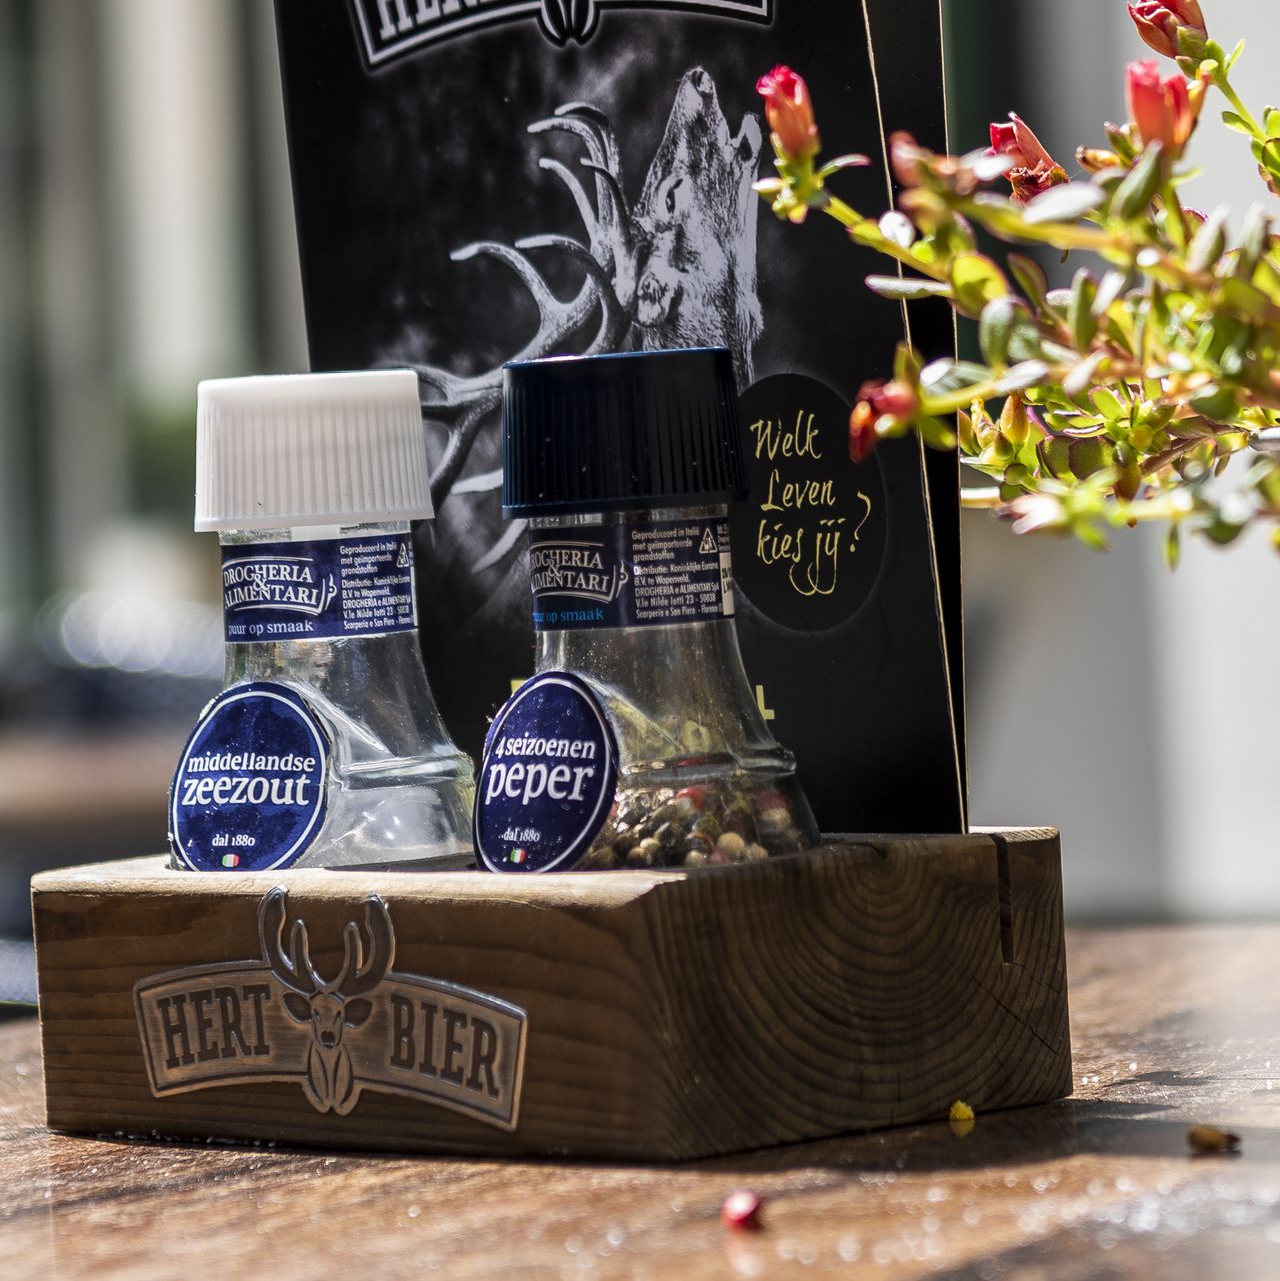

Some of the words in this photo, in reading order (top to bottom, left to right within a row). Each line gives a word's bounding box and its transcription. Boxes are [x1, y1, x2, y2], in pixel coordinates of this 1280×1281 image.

[749, 410, 822, 461] Welk
[760, 468, 836, 512] Leven
[632, 528, 677, 541] Geproduceerd
[678, 528, 684, 536] in
[757, 519, 804, 565] kies
[632, 542, 646, 551] met
[341, 557, 353, 565] met
[633, 550, 674, 563] grondstoffen
[223, 564, 314, 587] DROGHERIA
[253, 573, 269, 591] &
[634, 577, 646, 586] B.V.
[224, 585, 319, 610] ALIMENTARI
[635, 586, 674, 597] DROGHERIA
[680, 583, 711, 593] ALIMENTARI
[342, 598, 377, 609] DROGHERIA
[650, 597, 669, 606] Nilde
[686, 595, 694, 604] 23
[356, 608, 372, 618] Nilde
[546, 611, 558, 624] op
[561, 608, 604, 620] smaak
[636, 609, 664, 619] Scarperia
[670, 607, 680, 616] San
[249, 623, 264, 637] op
[266, 620, 314, 634] smaak
[187, 751, 315, 773] middellandse
[182, 774, 311, 806] zeezout
[485, 762, 594, 806] peper
[212, 834, 228, 847] dal
[231, 835, 256, 847] 1880
[503, 828, 518, 843] dal
[519, 830, 540, 843] 1880
[156, 984, 271, 1070] HERT
[389, 993, 500, 1102] BIER
